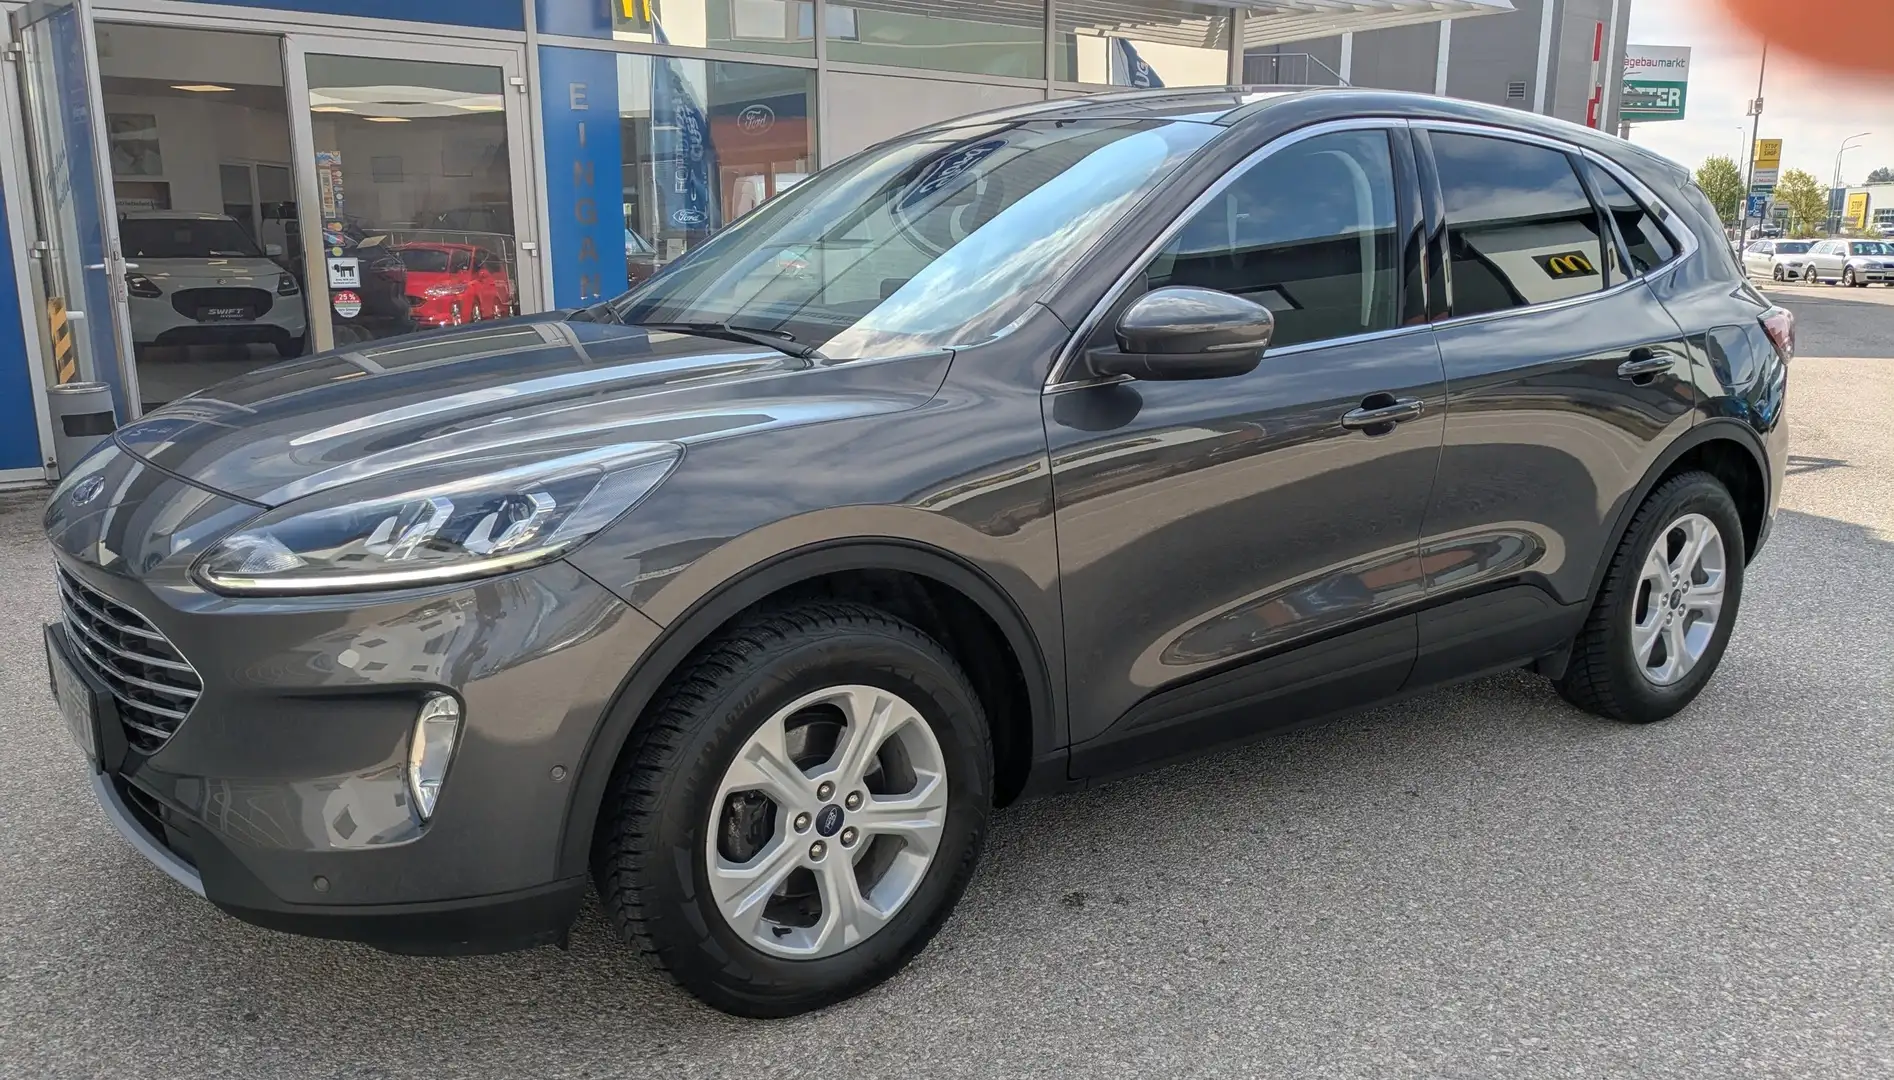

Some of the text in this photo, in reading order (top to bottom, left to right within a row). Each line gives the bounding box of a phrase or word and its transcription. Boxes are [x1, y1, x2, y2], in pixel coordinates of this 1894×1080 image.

[1624, 57, 1686, 68] agebaumarkt
[677, 210, 702, 223] Ford
[338, 293, 347, 301] 25
